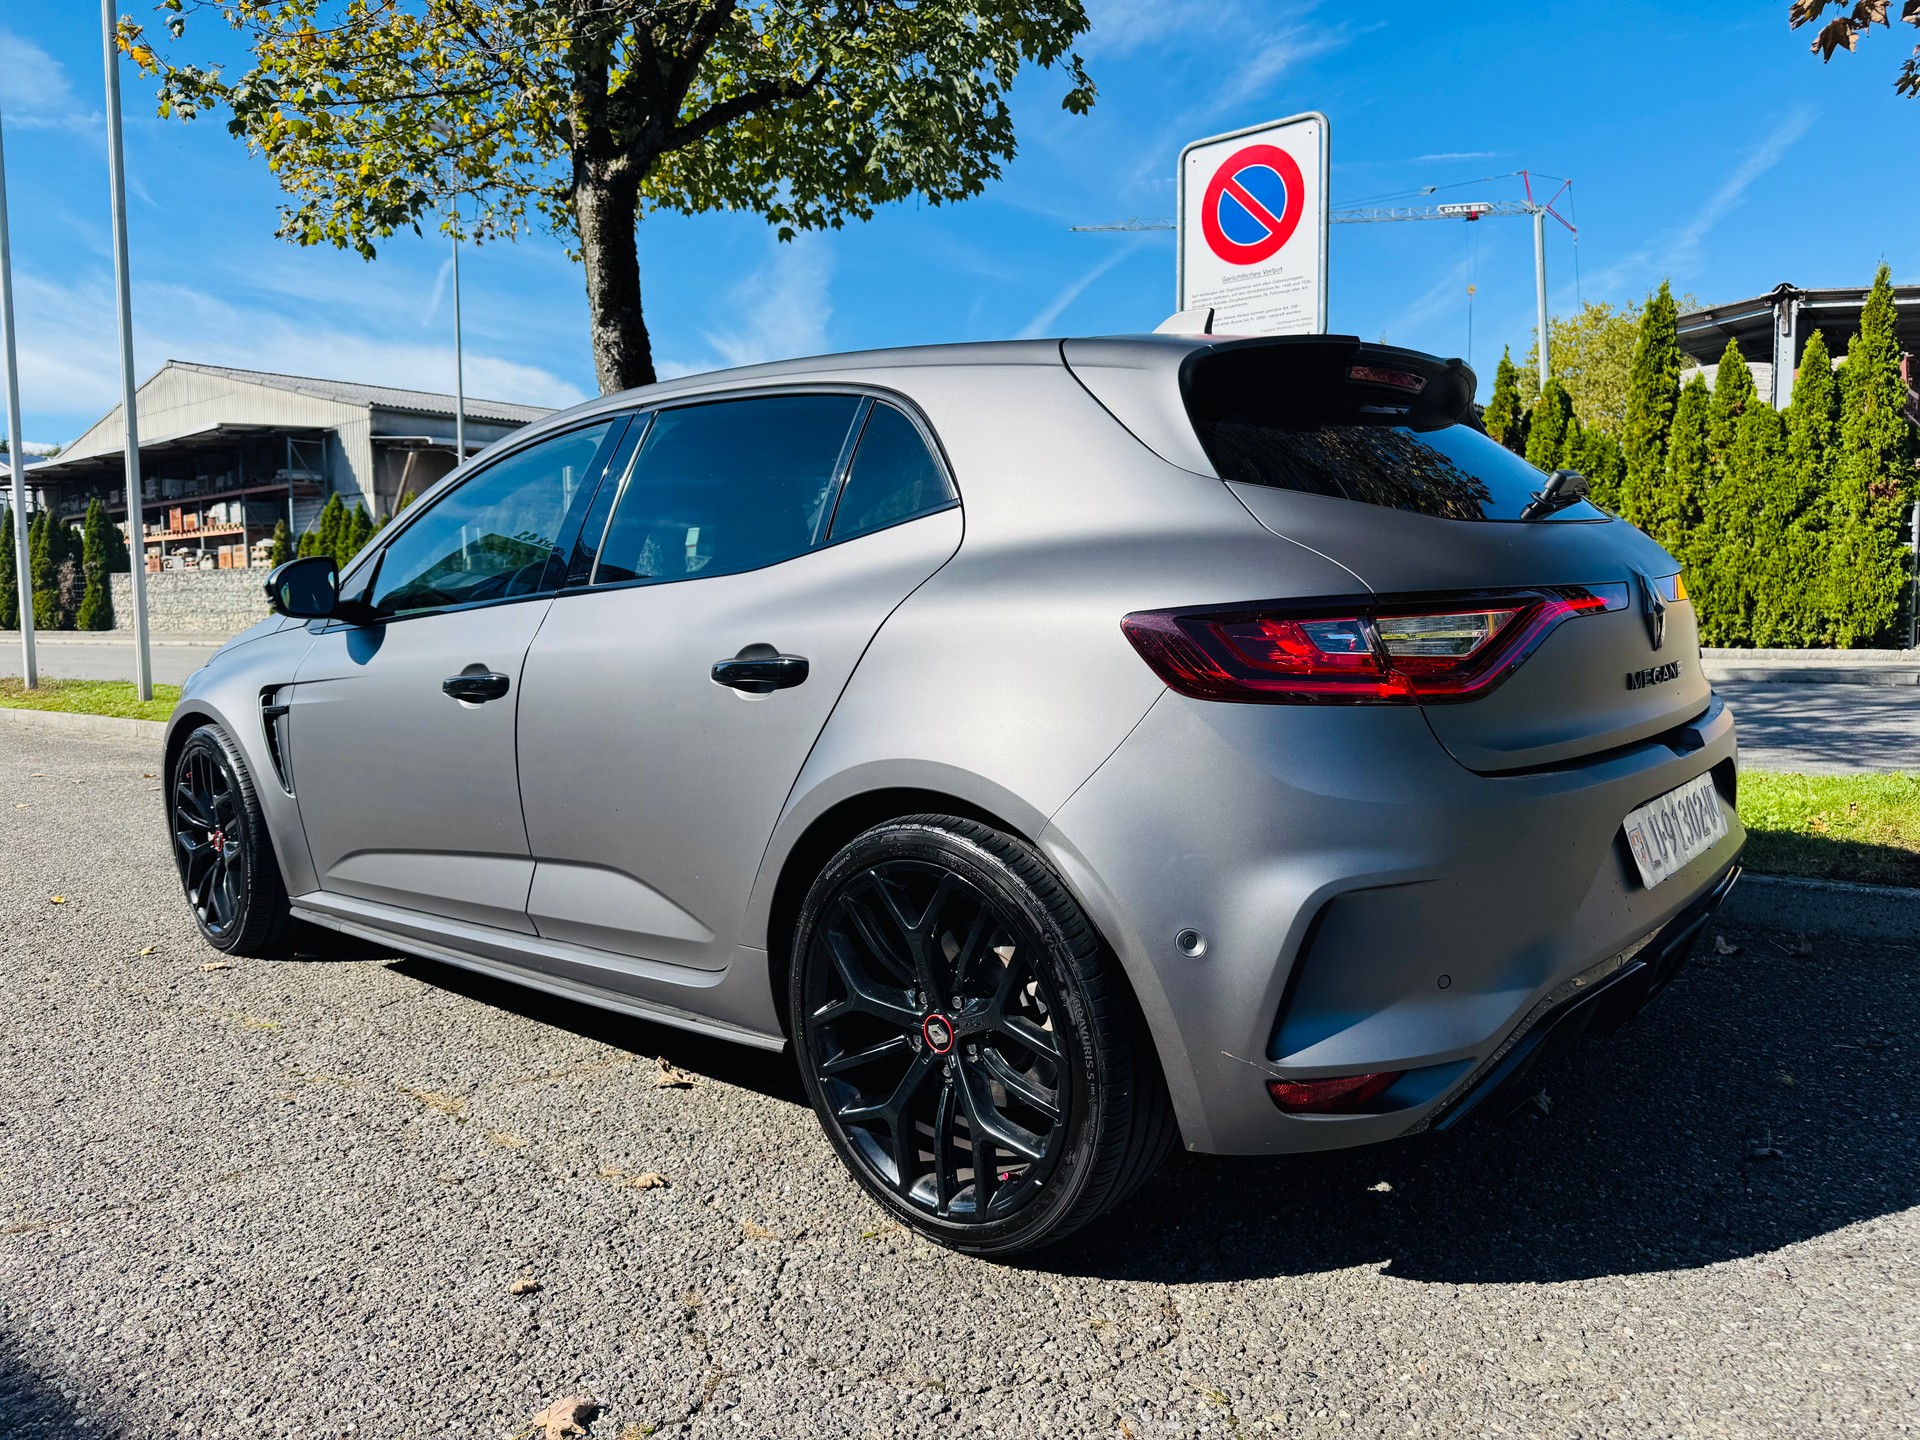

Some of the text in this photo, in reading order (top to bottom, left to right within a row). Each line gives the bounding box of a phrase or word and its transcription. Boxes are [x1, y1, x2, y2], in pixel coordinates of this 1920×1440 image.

[1222, 267, 1283, 282] Gerichtliches Verbot
[1074, 999, 1094, 1069] BRAVURIS
[1086, 1069, 1095, 1081] 5
